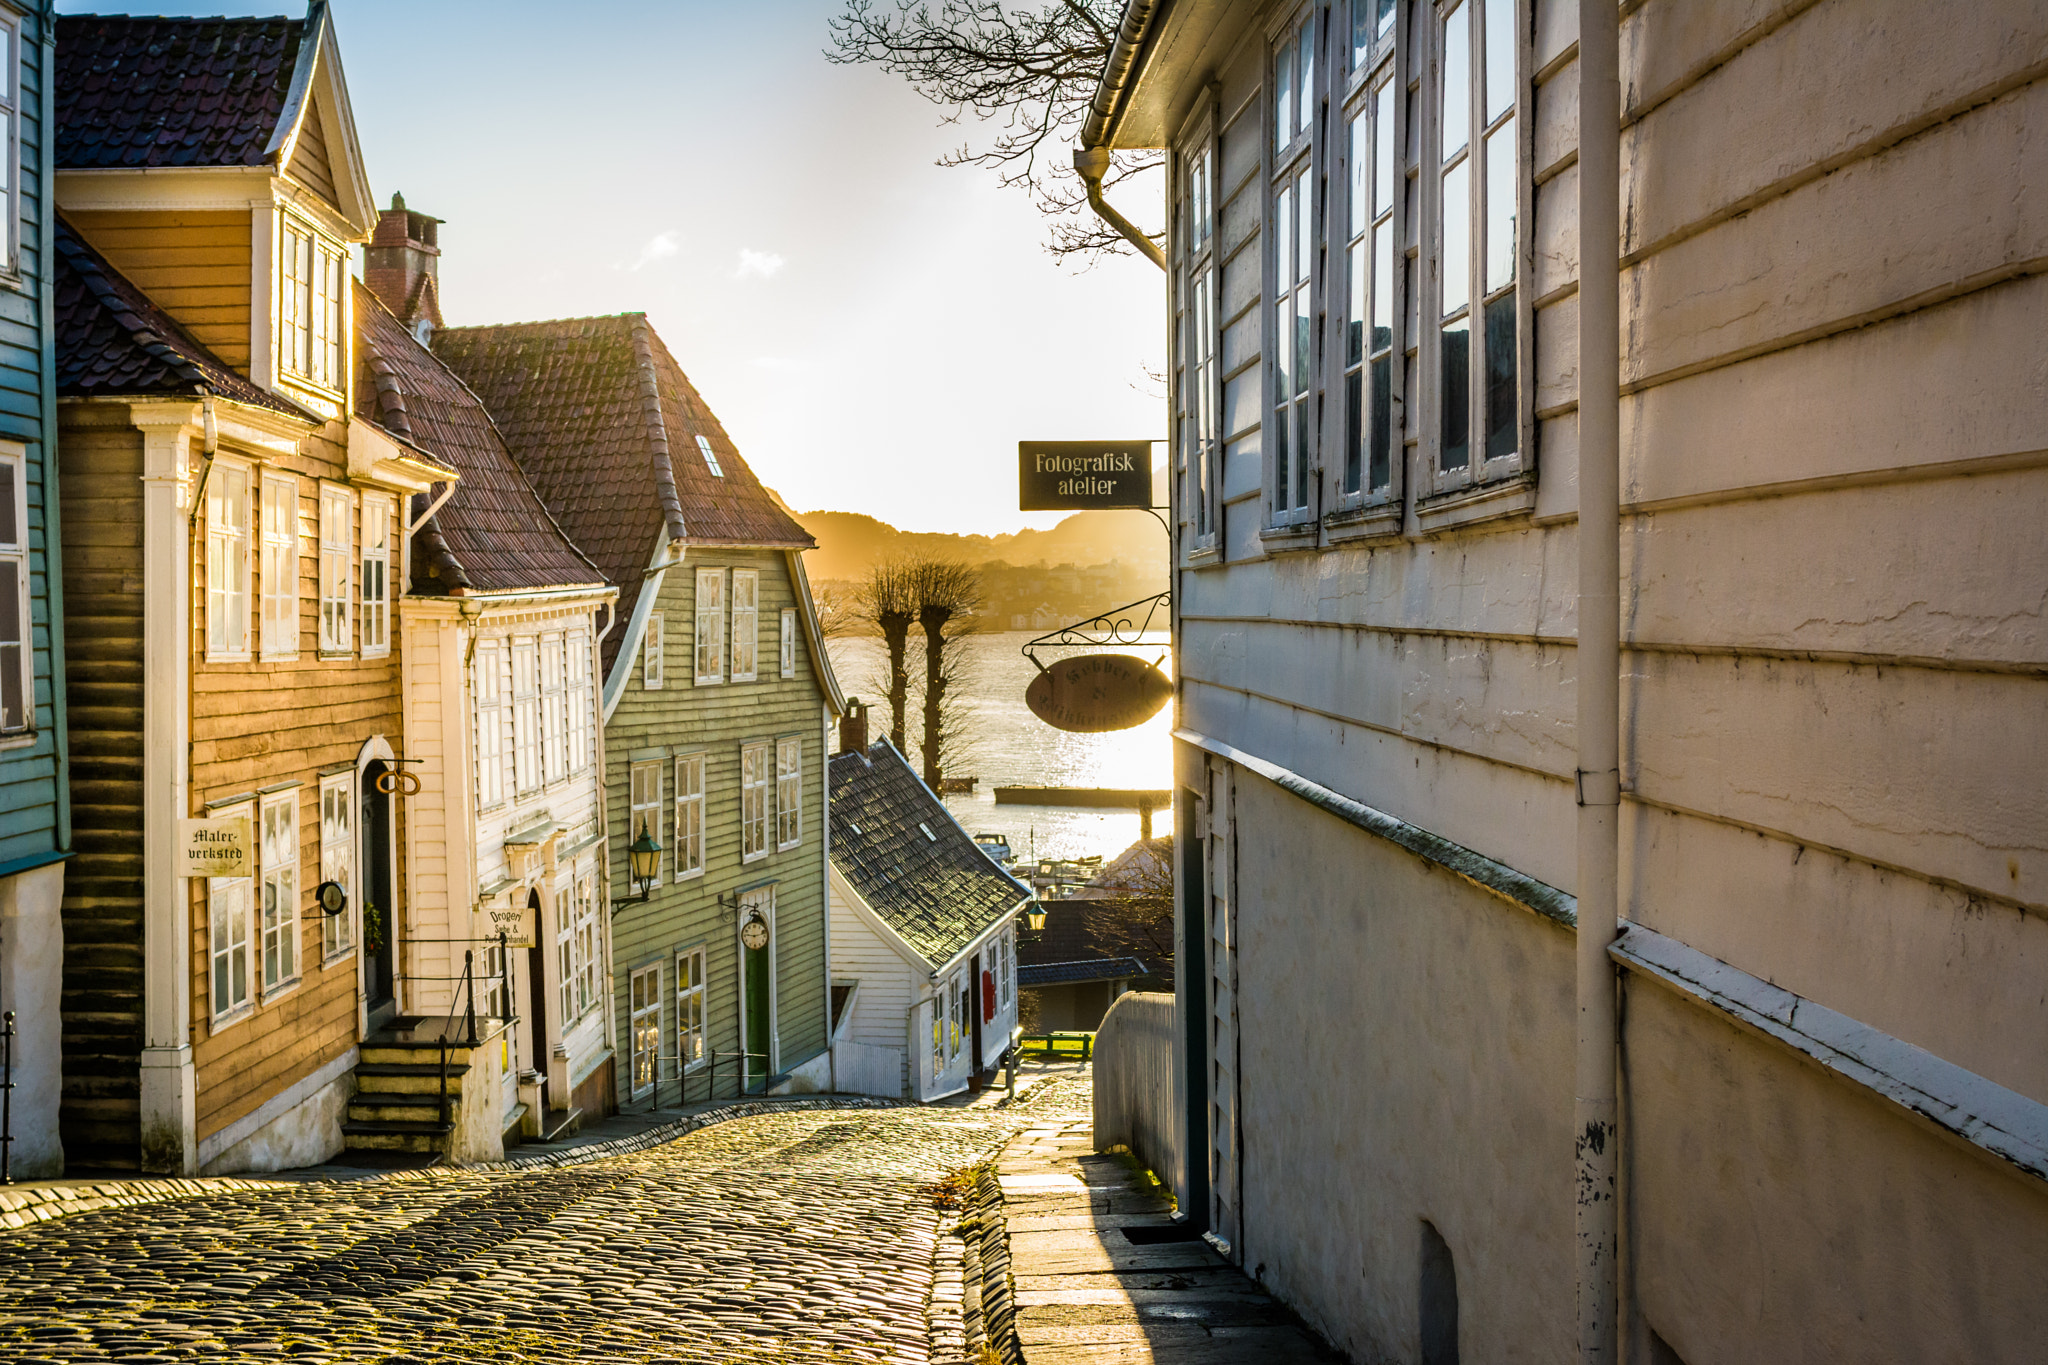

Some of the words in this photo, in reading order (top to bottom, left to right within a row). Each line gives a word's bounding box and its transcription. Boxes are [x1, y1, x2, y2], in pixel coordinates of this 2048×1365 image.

[1035, 452, 1135, 476] Fotografisk
[1058, 476, 1118, 495] atelier
[193, 829, 238, 843] Maler-
[188, 847, 243, 859] verksted
[490, 911, 524, 923] Drogeri
[512, 924, 519, 934] &
